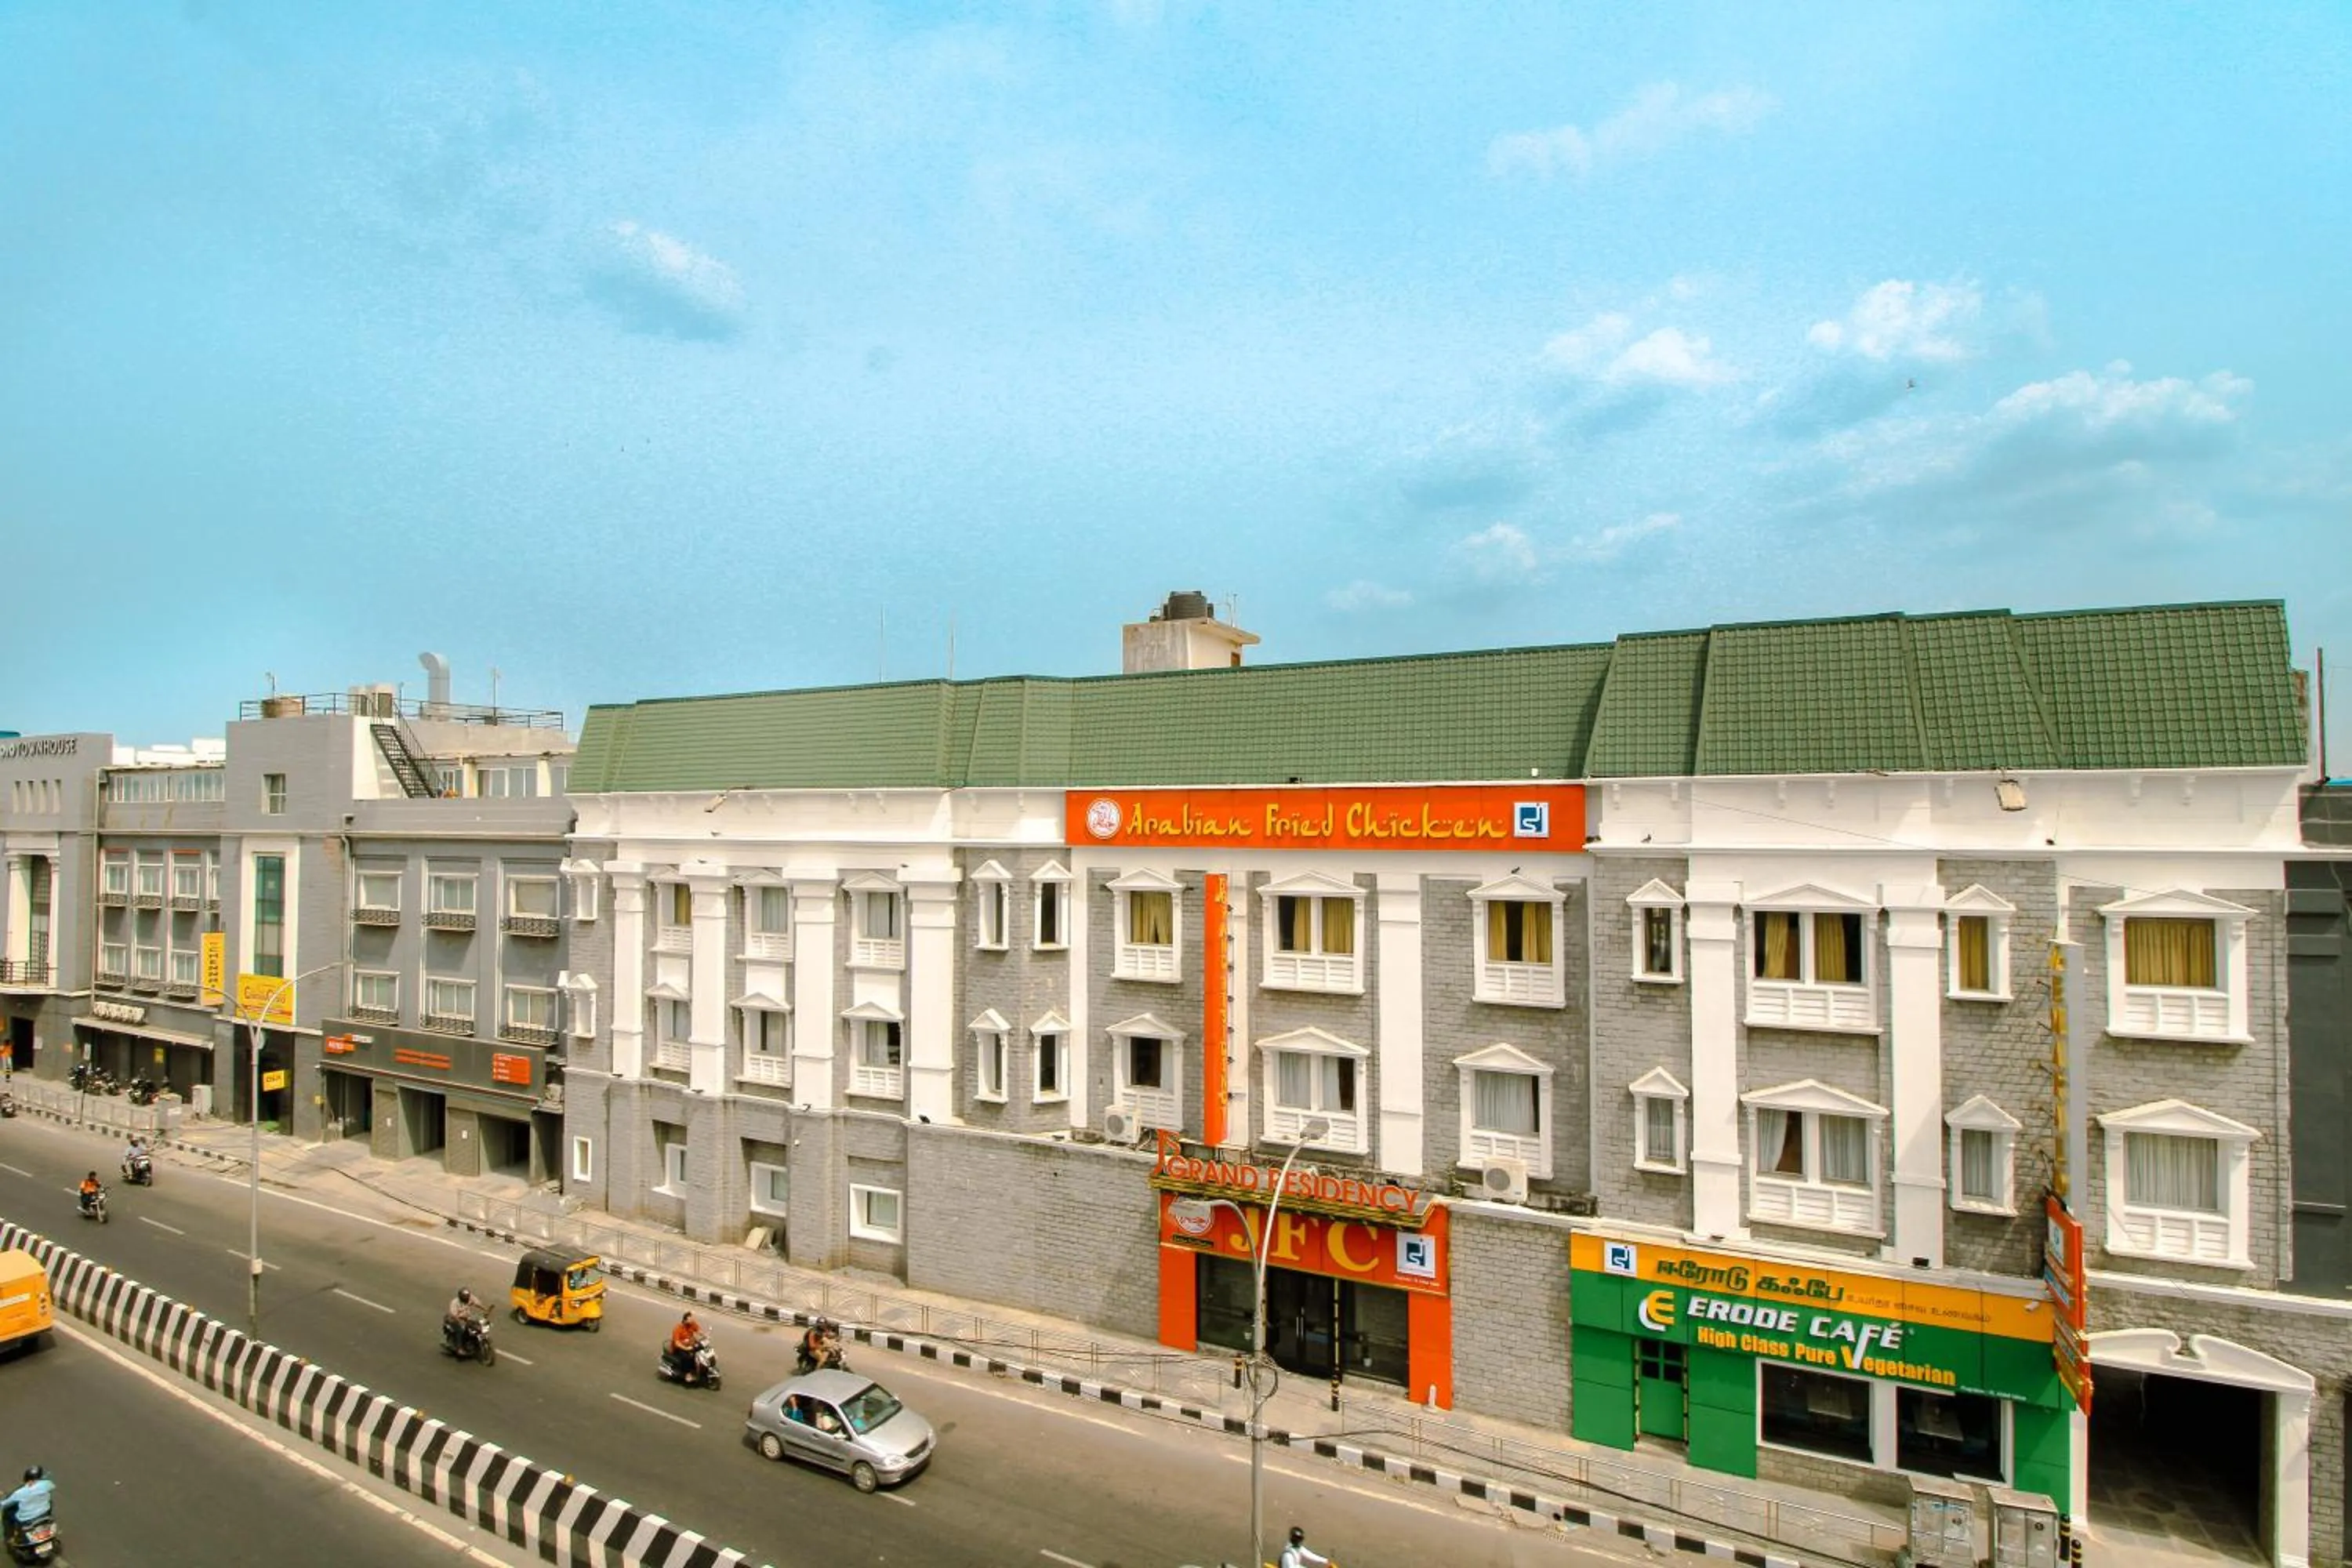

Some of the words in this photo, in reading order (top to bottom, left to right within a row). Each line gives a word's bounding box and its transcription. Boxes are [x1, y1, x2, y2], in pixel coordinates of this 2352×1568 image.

[1126, 802, 1252, 837] Arabian
[1265, 802, 1333, 837] Fried
[1346, 801, 1507, 838] Chicken
[1167, 1155, 1258, 1191] GRAND
[1267, 1167, 1420, 1215] RESIDENCY
[1687, 1296, 1799, 1332] ERODE
[1697, 1326, 1737, 1349] High
[1740, 1334, 1789, 1357] Class
[1795, 1342, 1836, 1366] Pure
